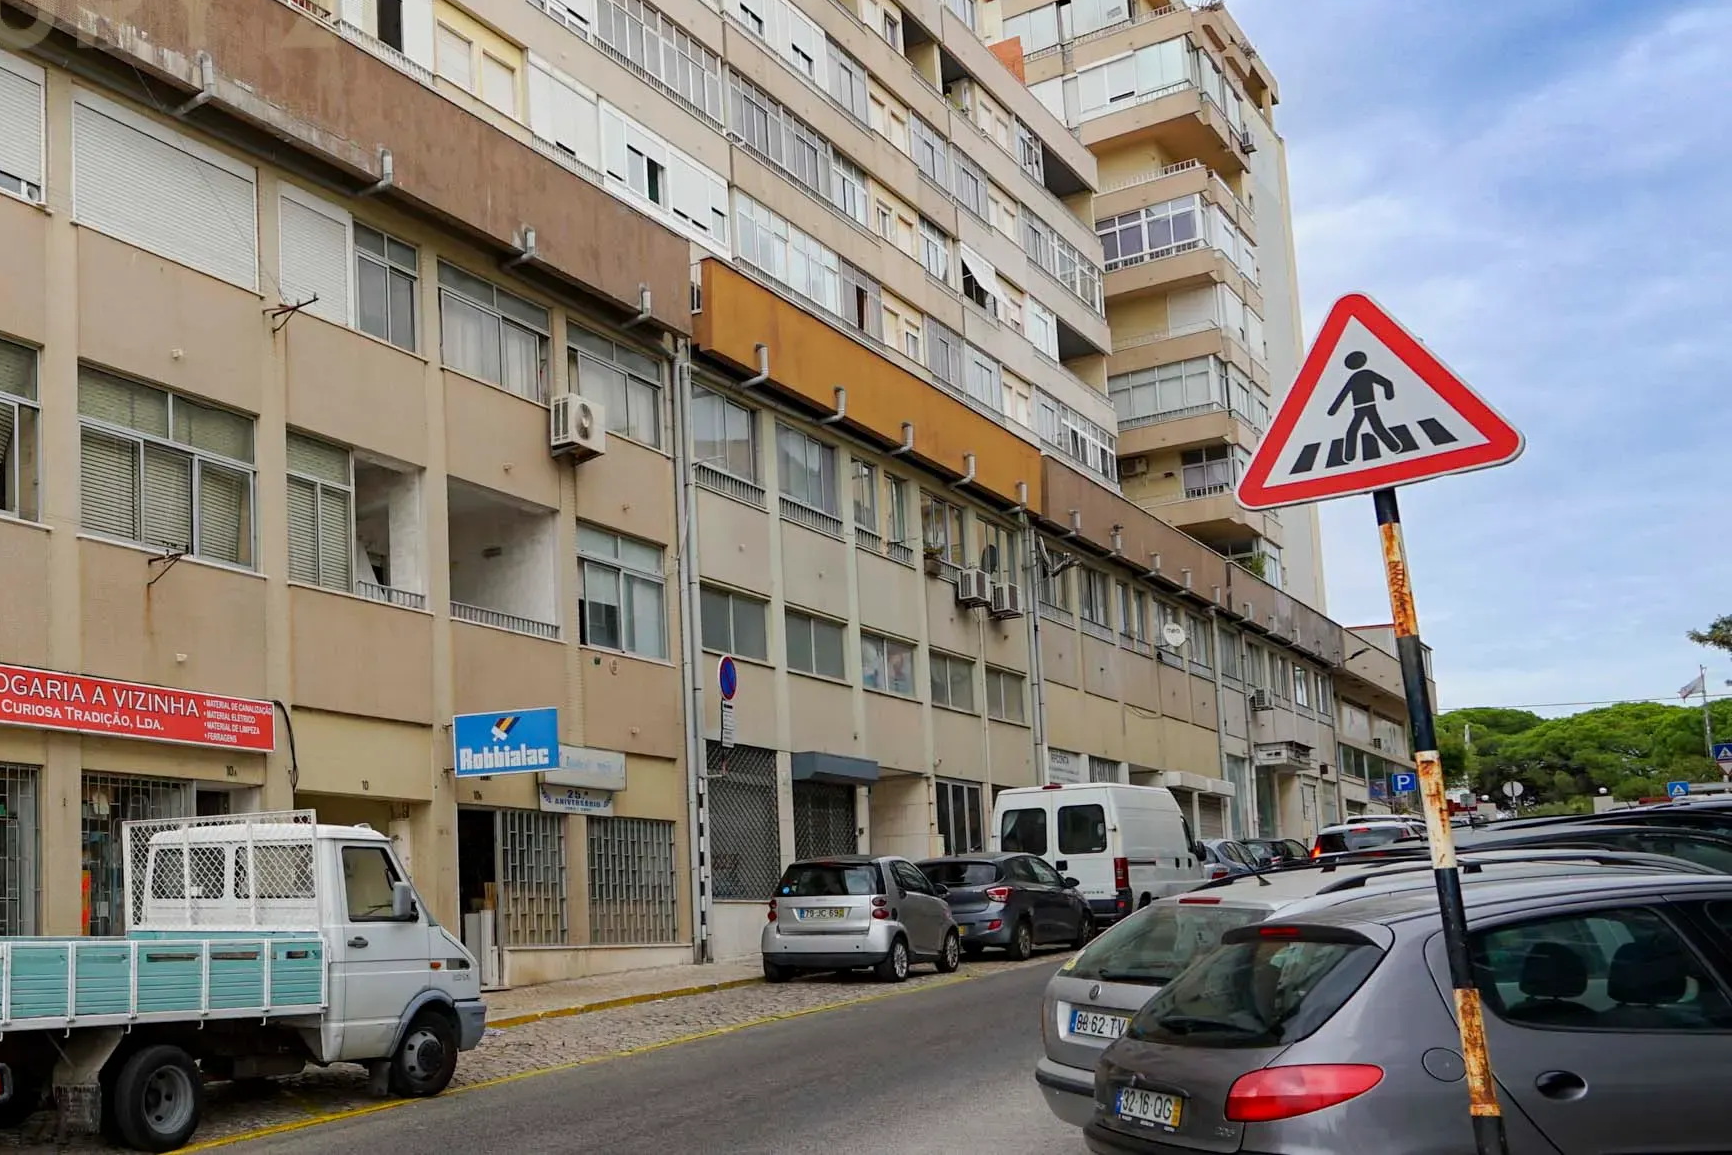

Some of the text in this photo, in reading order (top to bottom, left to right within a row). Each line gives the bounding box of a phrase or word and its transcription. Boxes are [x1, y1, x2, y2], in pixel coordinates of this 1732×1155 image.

[91, 685, 107, 706] A
[112, 687, 200, 718] VIZINHA
[459, 743, 549, 771] Robbialac
[1396, 775, 1411, 790] P
